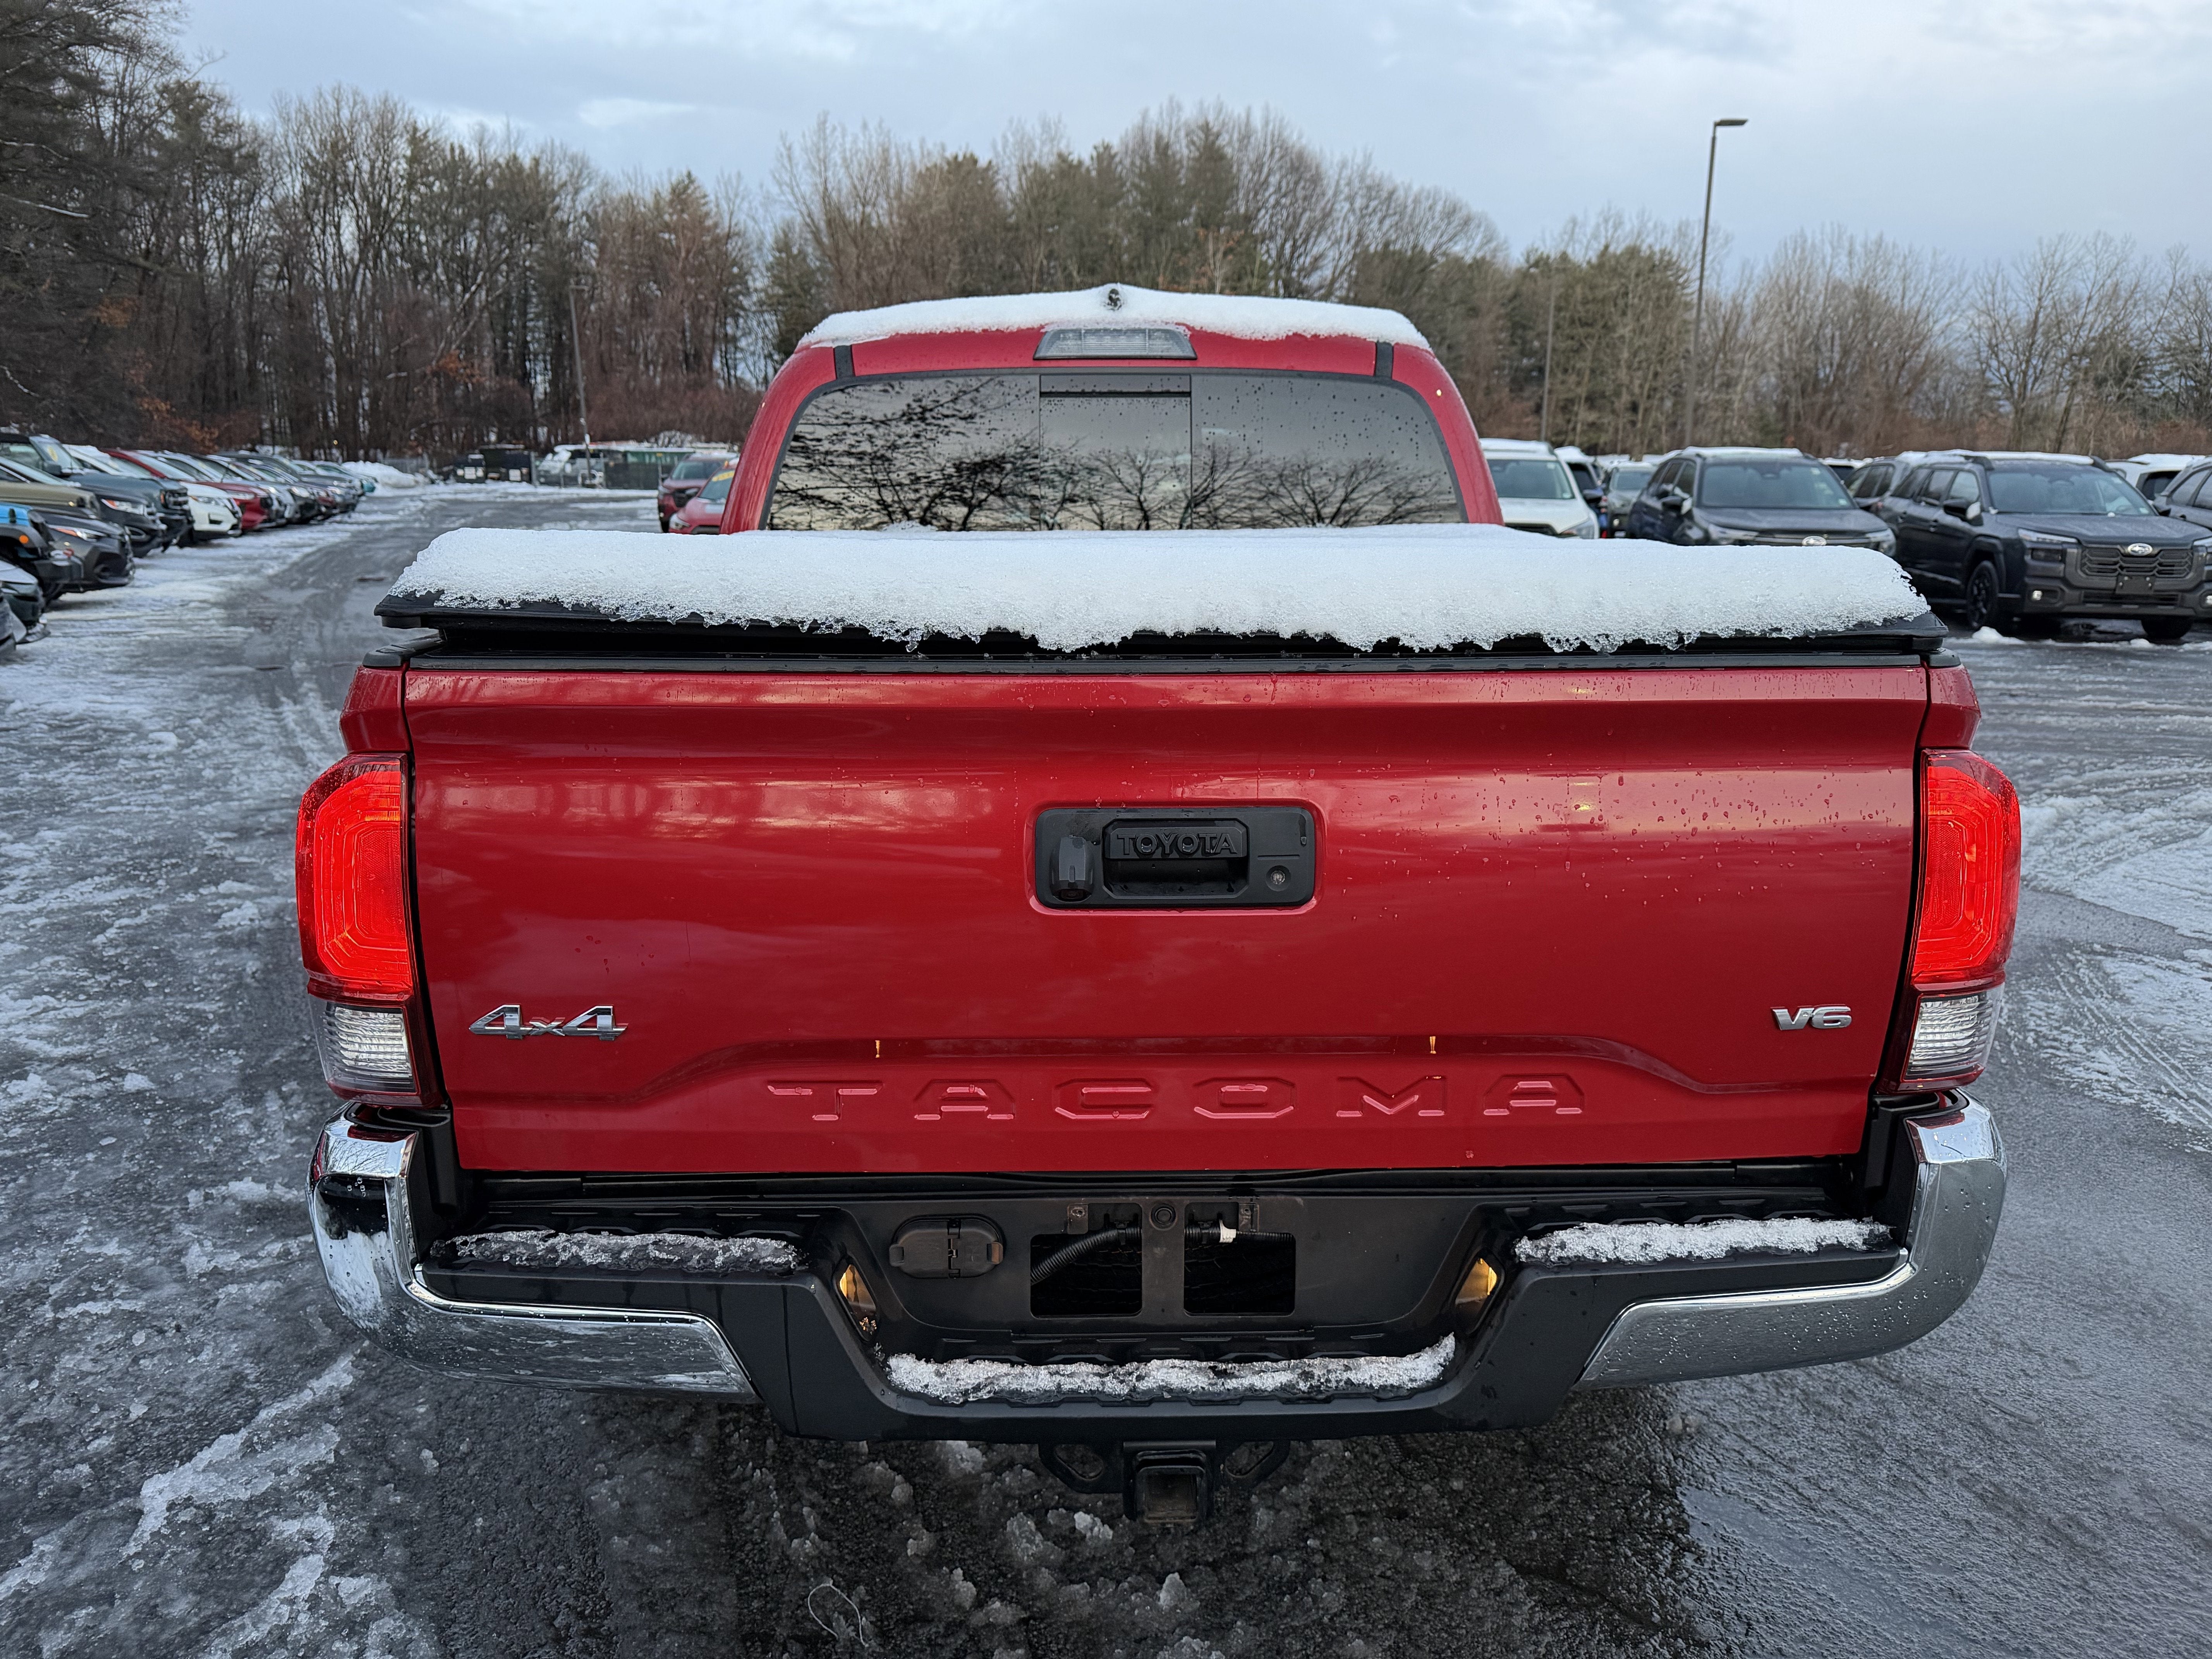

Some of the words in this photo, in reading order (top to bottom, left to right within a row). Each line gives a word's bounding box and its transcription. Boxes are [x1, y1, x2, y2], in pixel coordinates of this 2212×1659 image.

[1117, 833, 1237, 855] TOYOTA
[1772, 1005, 1852, 1030] V6
[767, 1073, 1585, 1121] TACOMA
